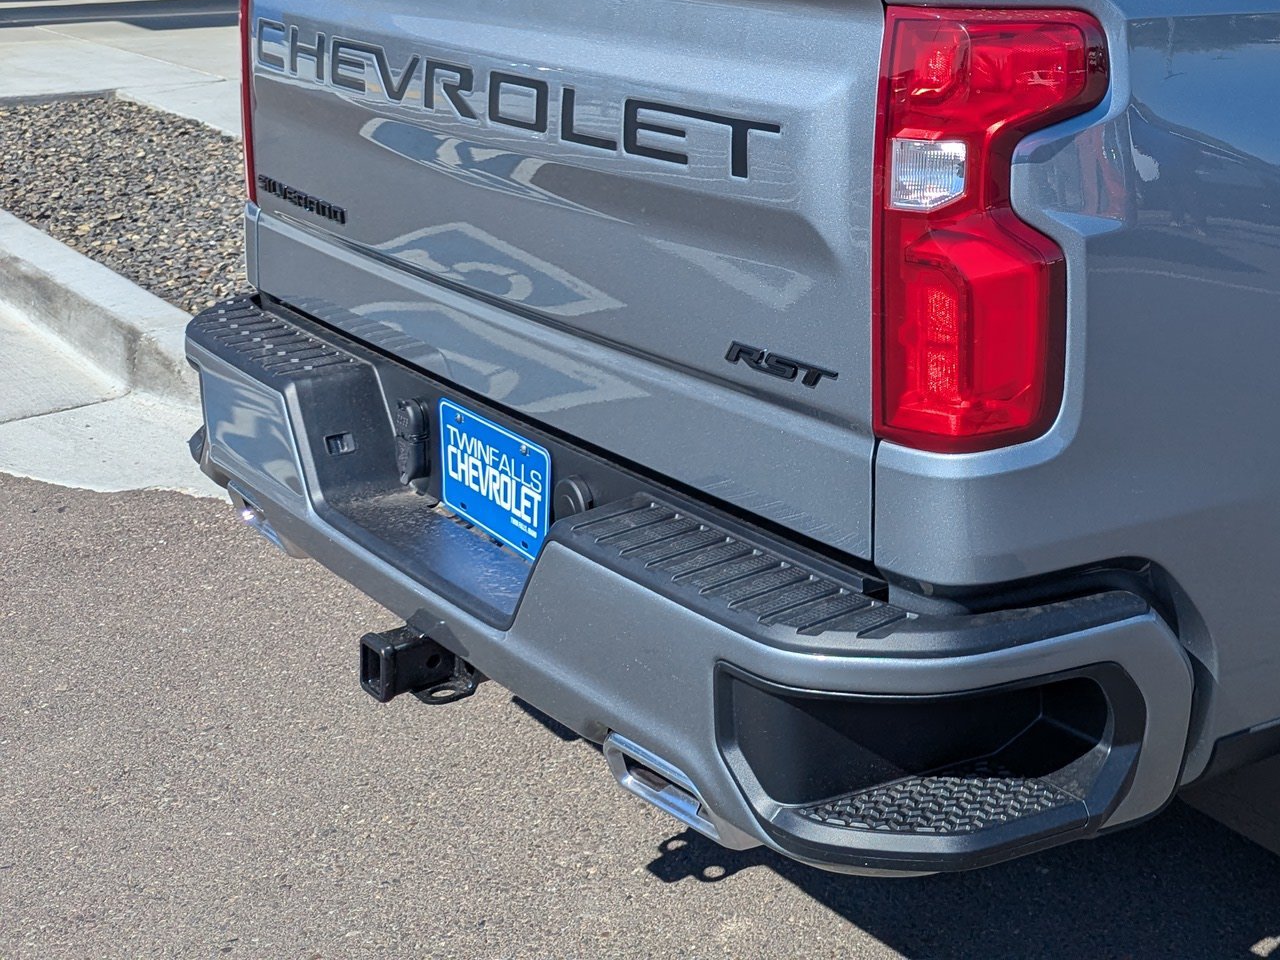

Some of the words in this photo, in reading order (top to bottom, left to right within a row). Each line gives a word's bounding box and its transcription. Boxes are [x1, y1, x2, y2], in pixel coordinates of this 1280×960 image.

[256, 16, 781, 178] CHEVROLET
[258, 173, 347, 224] SILVERADO
[724, 340, 838, 389] RST
[447, 444, 542, 528] CHEVROLET
